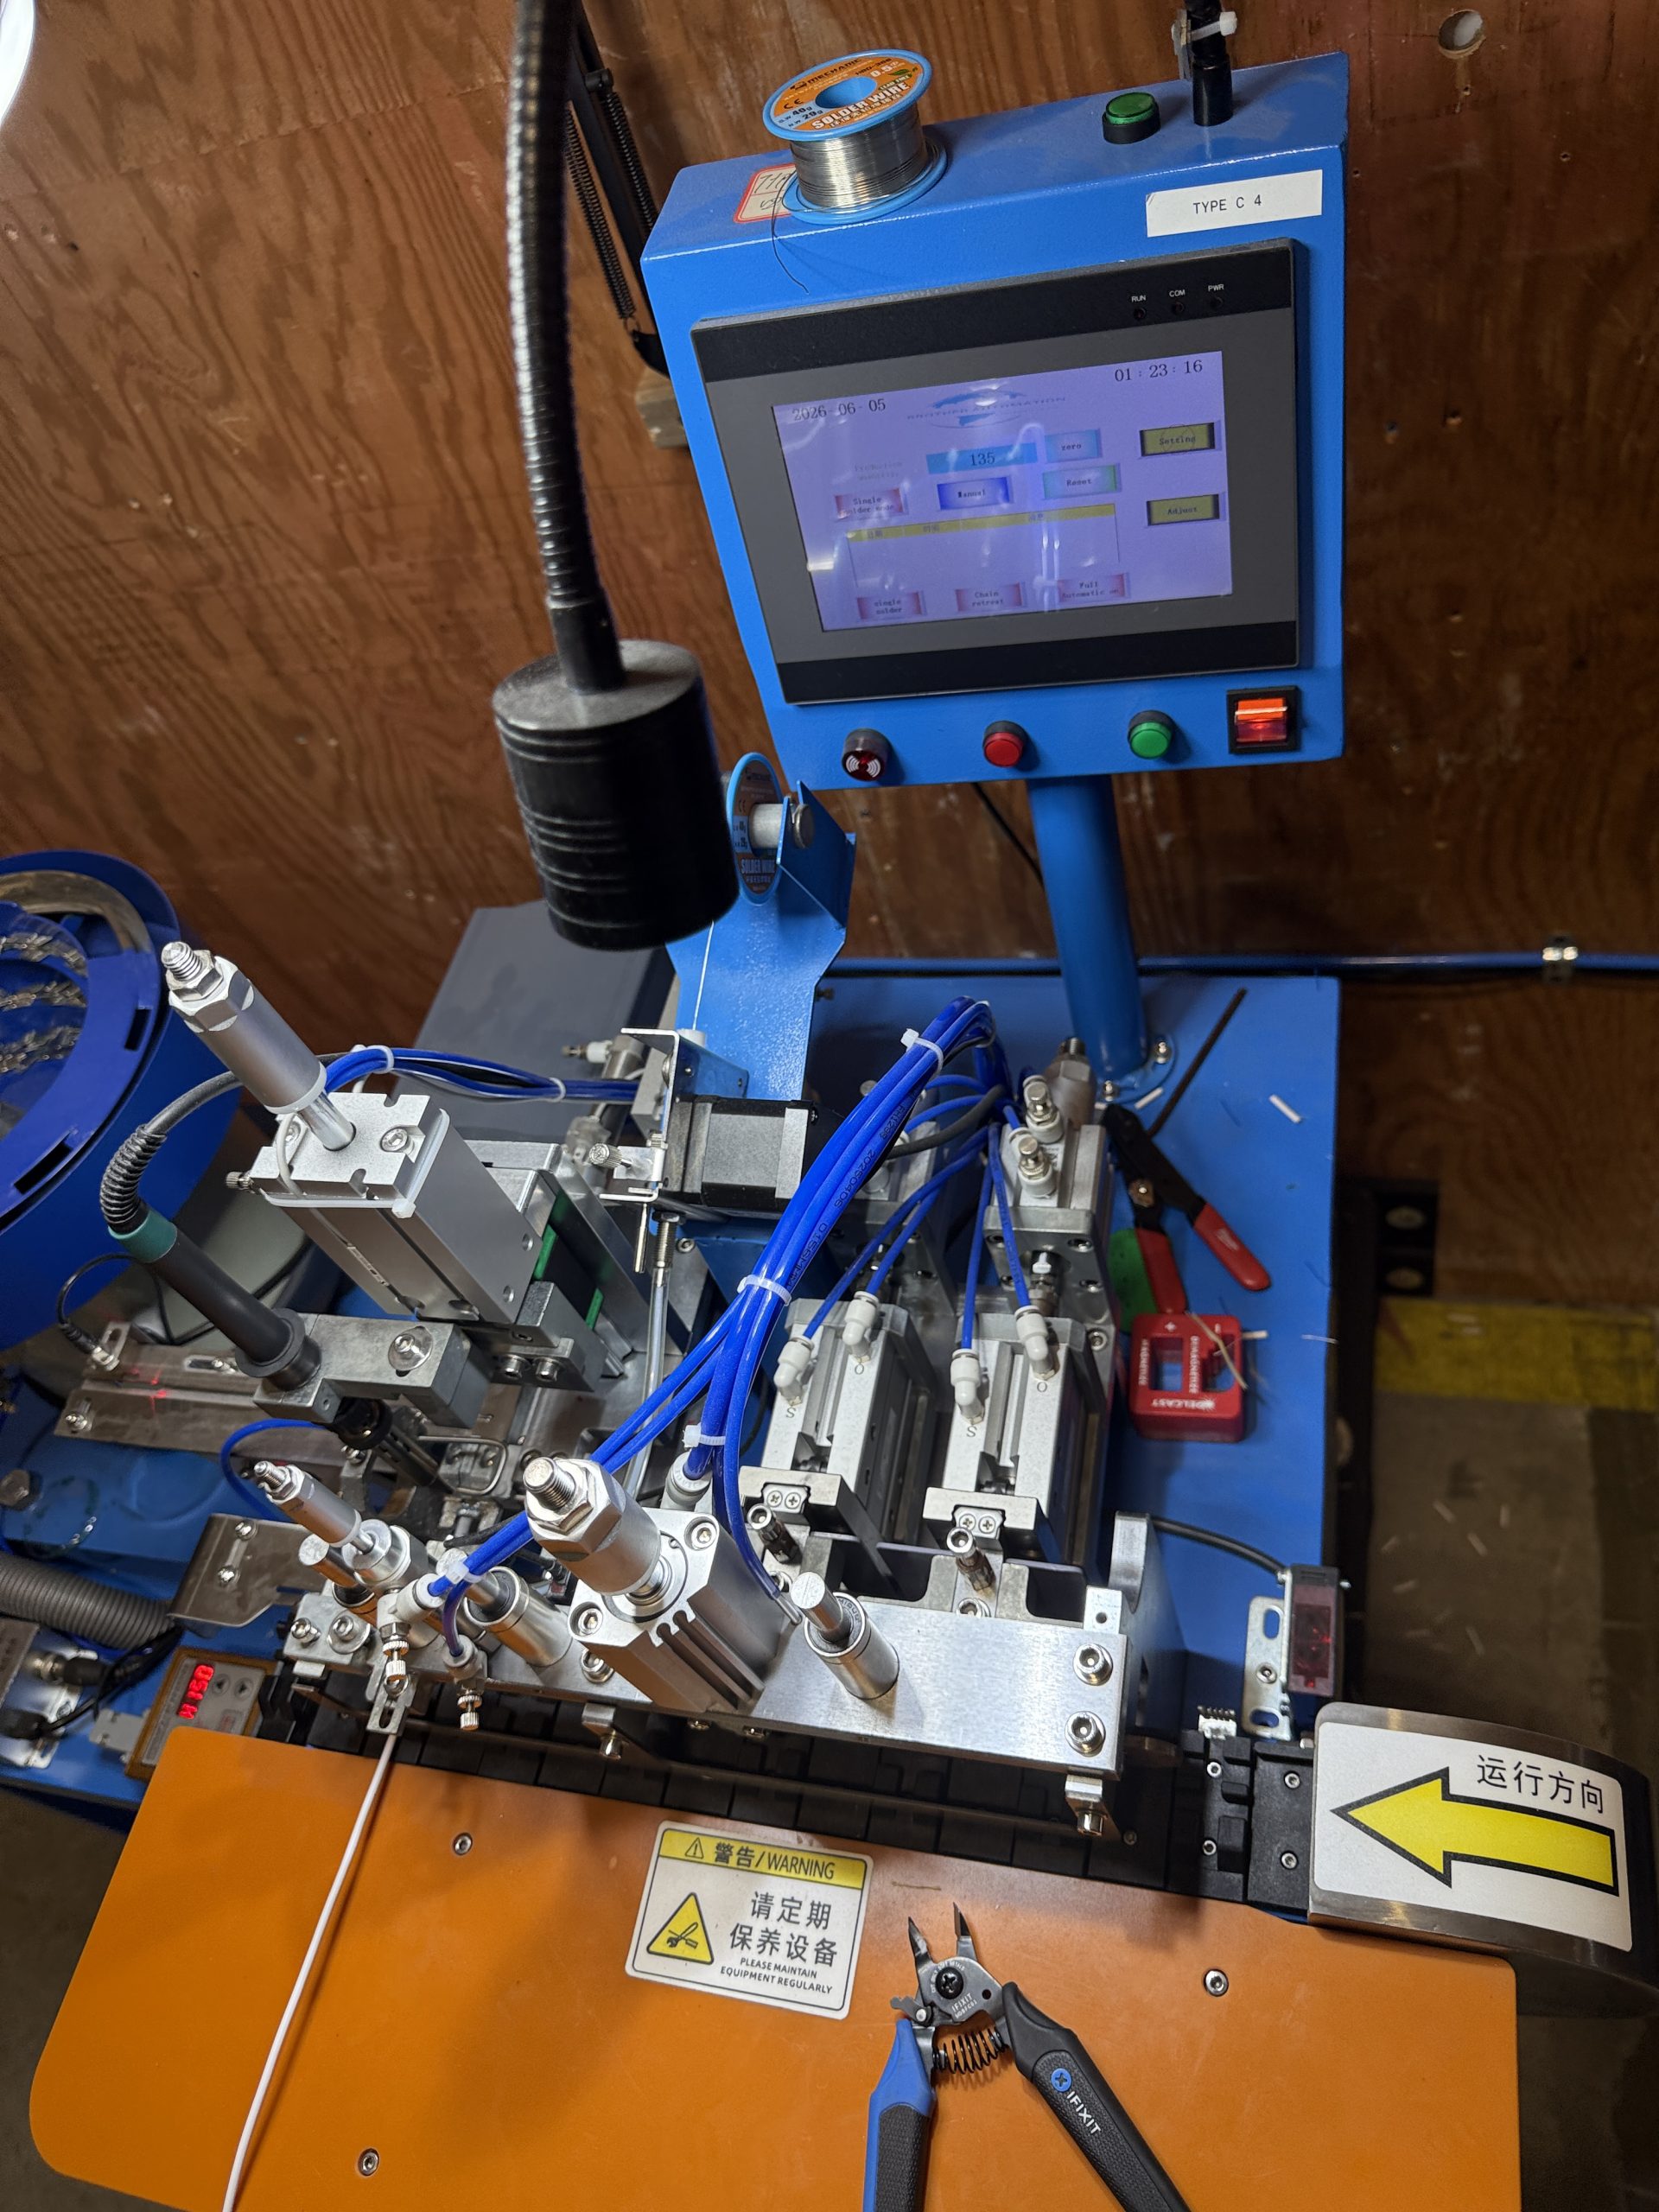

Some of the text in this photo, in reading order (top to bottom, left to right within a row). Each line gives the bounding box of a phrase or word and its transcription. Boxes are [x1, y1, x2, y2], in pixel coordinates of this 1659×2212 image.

[811, 99, 869, 130] SOLDER
[868, 81, 911, 104] WIRE
[1192, 194, 1262, 214] TYPE C 4
[1169, 289, 1185, 297] COM
[1208, 283, 1224, 292] PWR
[1159, 435, 1196, 446] Setting
[969, 451, 995, 466] 135
[1066, 477, 1092, 486] Reset
[852, 495, 882, 505] Single
[957, 488, 986, 499] Manual
[1167, 505, 1198, 516] Adjust
[974, 589, 999, 599] Chain
[785, 1407, 797, 1419] S
[966, 1426, 977, 1438] S
[1477, 1754, 1604, 1814] 运行方向
[750, 1891, 831, 1930] 请定期
[729, 1923, 837, 1967] 保养设备
[740, 1957, 817, 1979] PLEASE MAINTAIN
[720, 1966, 833, 1995] EQUIPMENT REGULARLY
[951, 1993, 973, 2012] IFIXIT
[1066, 2091, 1102, 2134] IFIXIT
